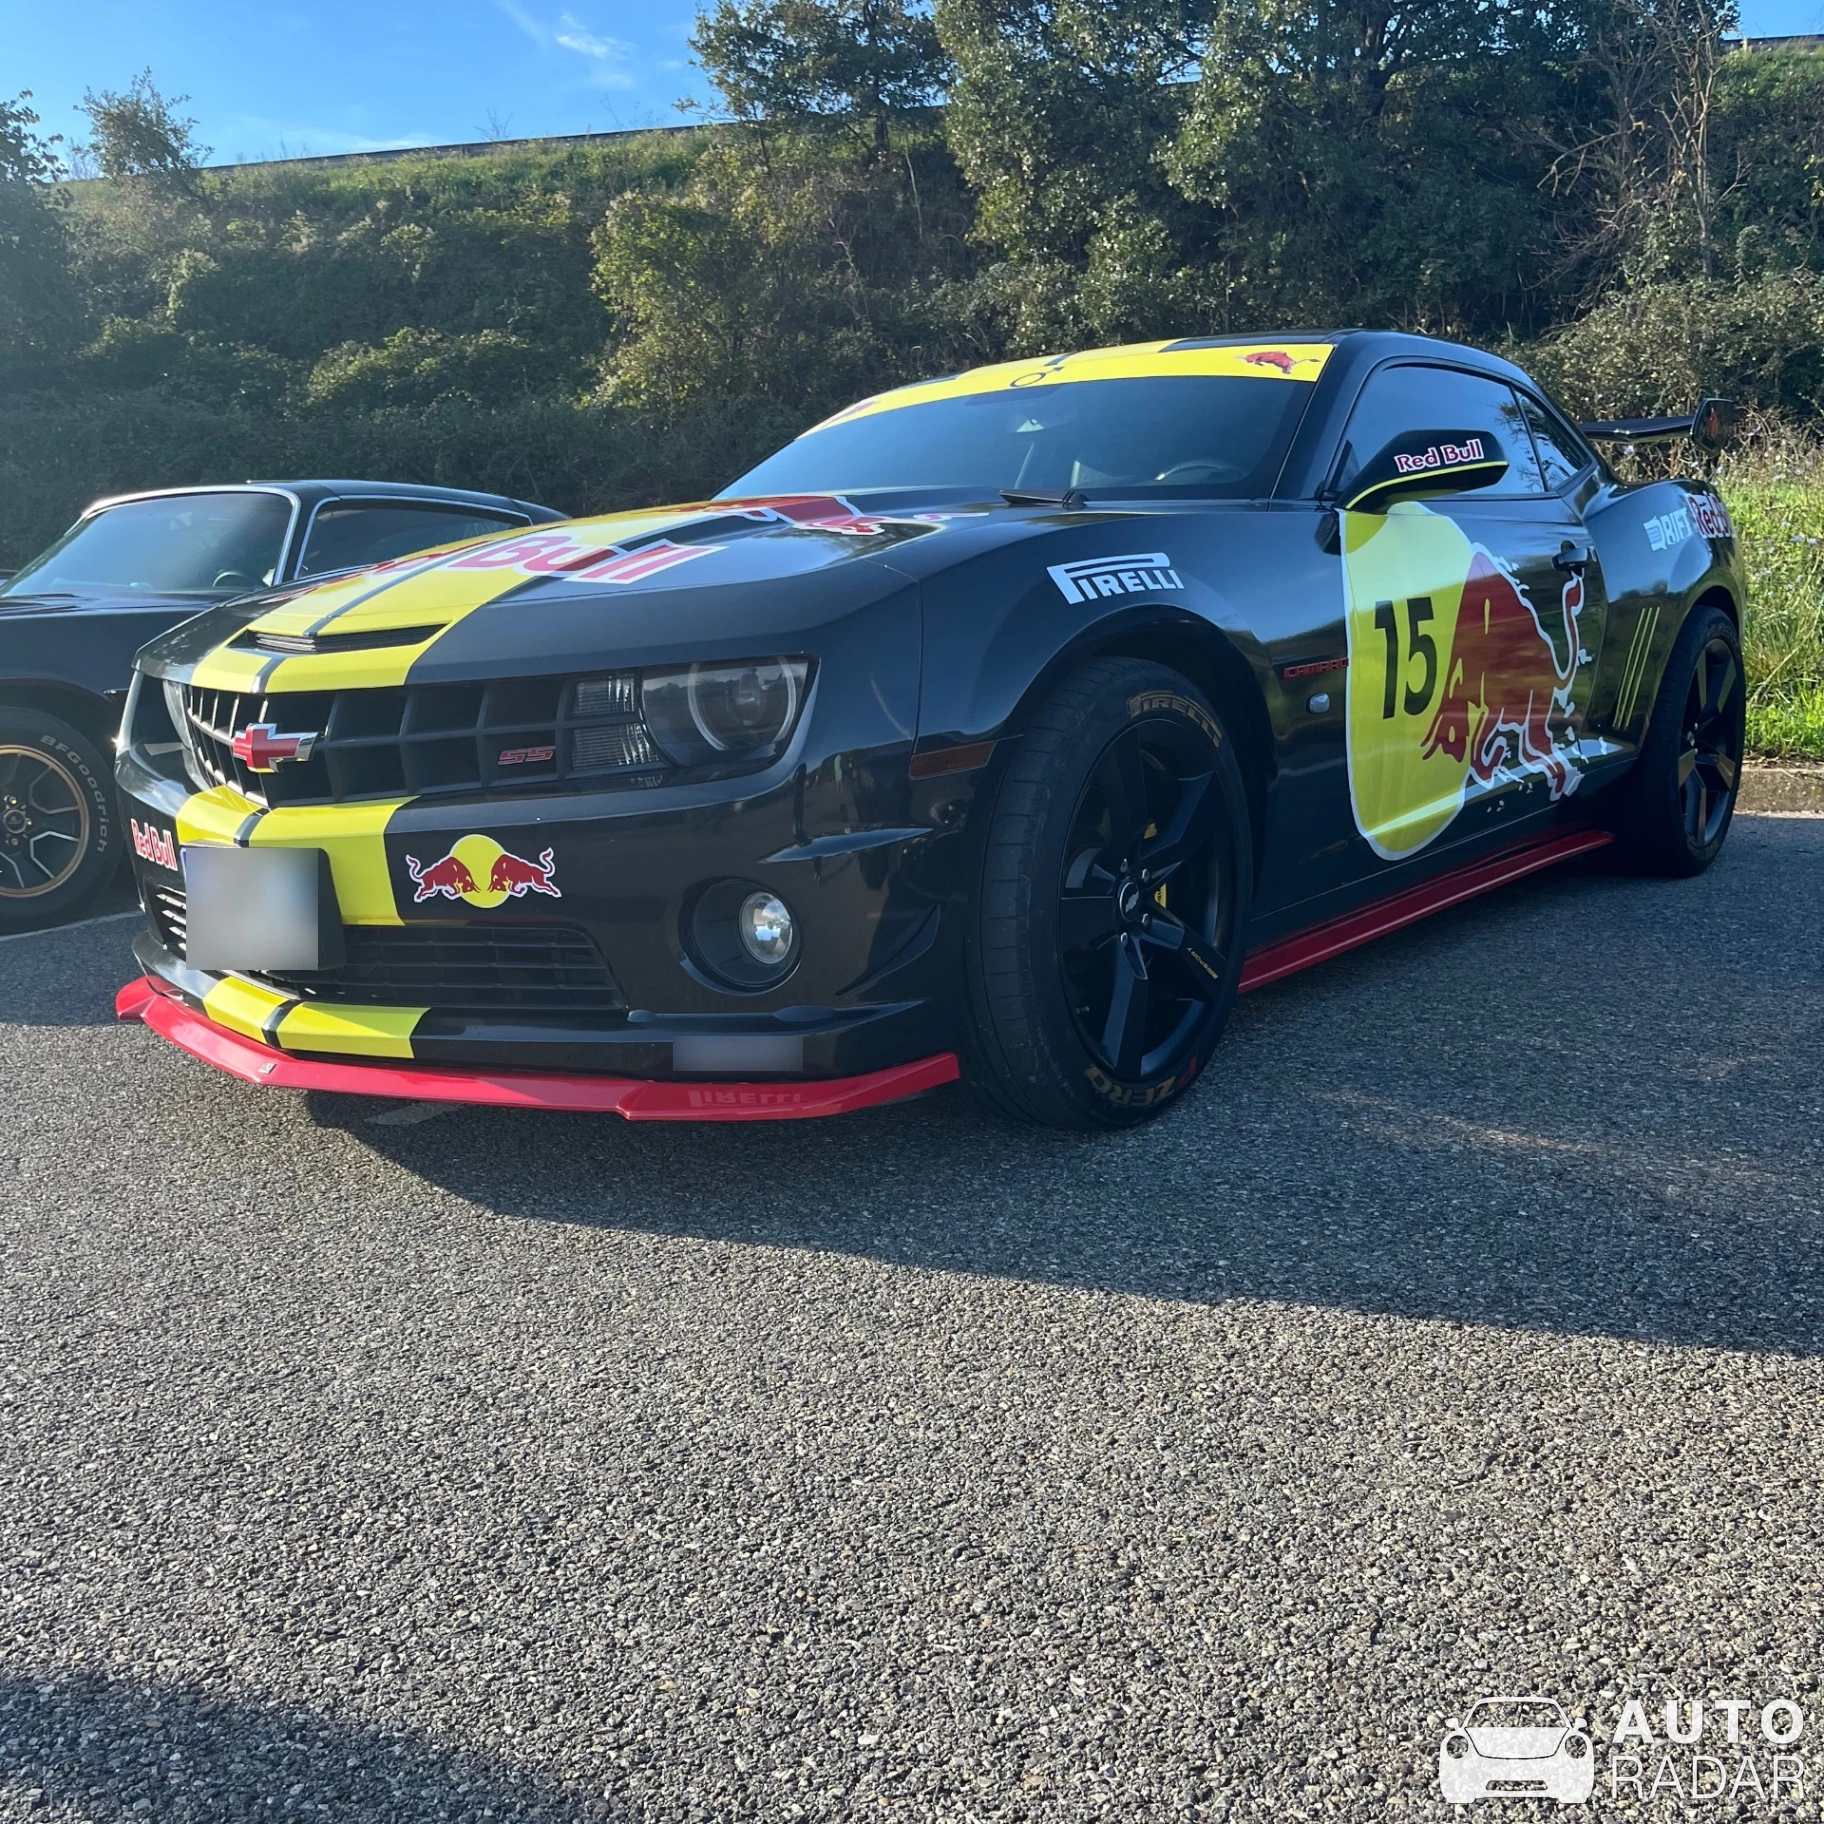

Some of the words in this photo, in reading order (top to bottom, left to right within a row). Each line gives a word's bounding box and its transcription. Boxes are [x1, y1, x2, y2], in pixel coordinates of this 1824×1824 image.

[1394, 447, 1440, 473] Red
[1440, 438, 1485, 465] Bull
[439, 533, 728, 585] Bull
[1046, 552, 1184, 605] PIRELLI
[1283, 657, 1349, 679] CAMARO
[1373, 596, 1437, 720] 15
[1127, 689, 1223, 748] PIRELLI
[497, 745, 557, 766] SS
[40, 734, 109, 852] BFGoodrich
[131, 818, 155, 862] Red
[150, 825, 178, 871] Bull
[1085, 1064, 1177, 1106] ZERO
